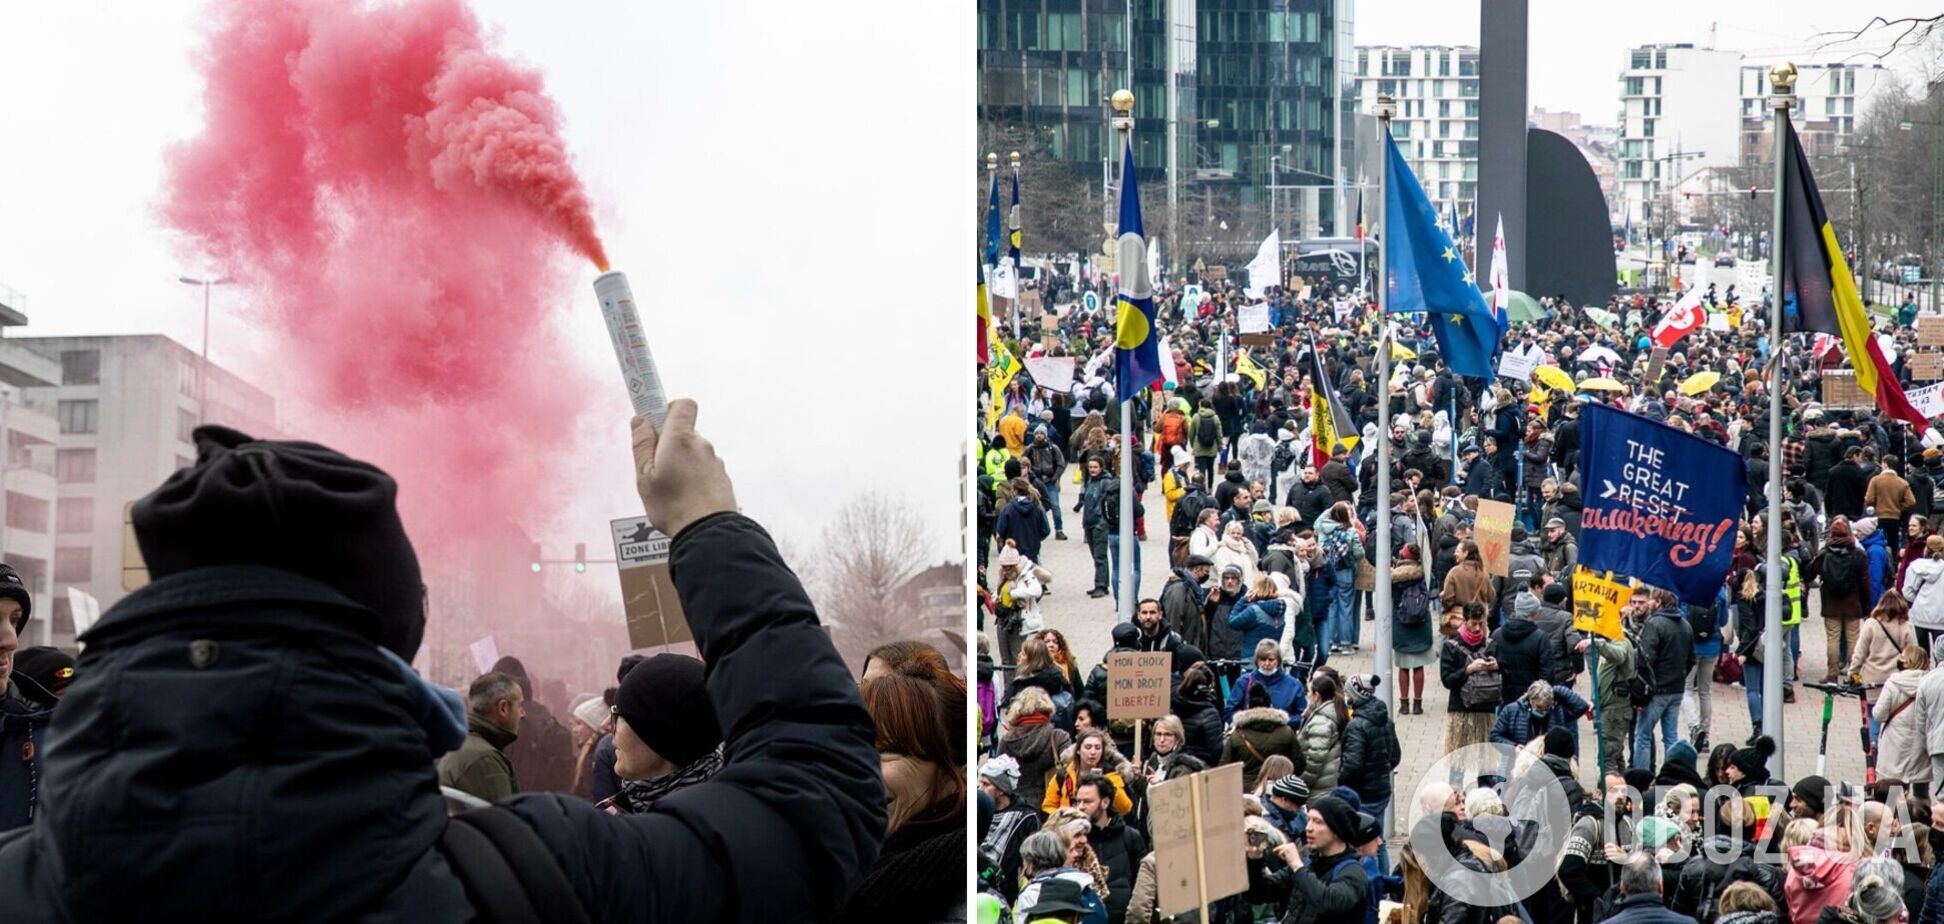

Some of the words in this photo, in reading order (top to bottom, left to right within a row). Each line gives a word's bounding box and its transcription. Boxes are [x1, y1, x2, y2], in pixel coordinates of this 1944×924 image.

[1626, 439, 1665, 469] THE
[1623, 463, 1689, 501] GREAT
[1619, 484, 1686, 524] RESET
[625, 544, 650, 555] ZONE
[1581, 507, 1733, 567] awakening!
[1114, 657, 1133, 667] MON
[1137, 656, 1165, 667] CHOIX
[1114, 678, 1133, 690] MON
[1137, 677, 1163, 689] DROIT
